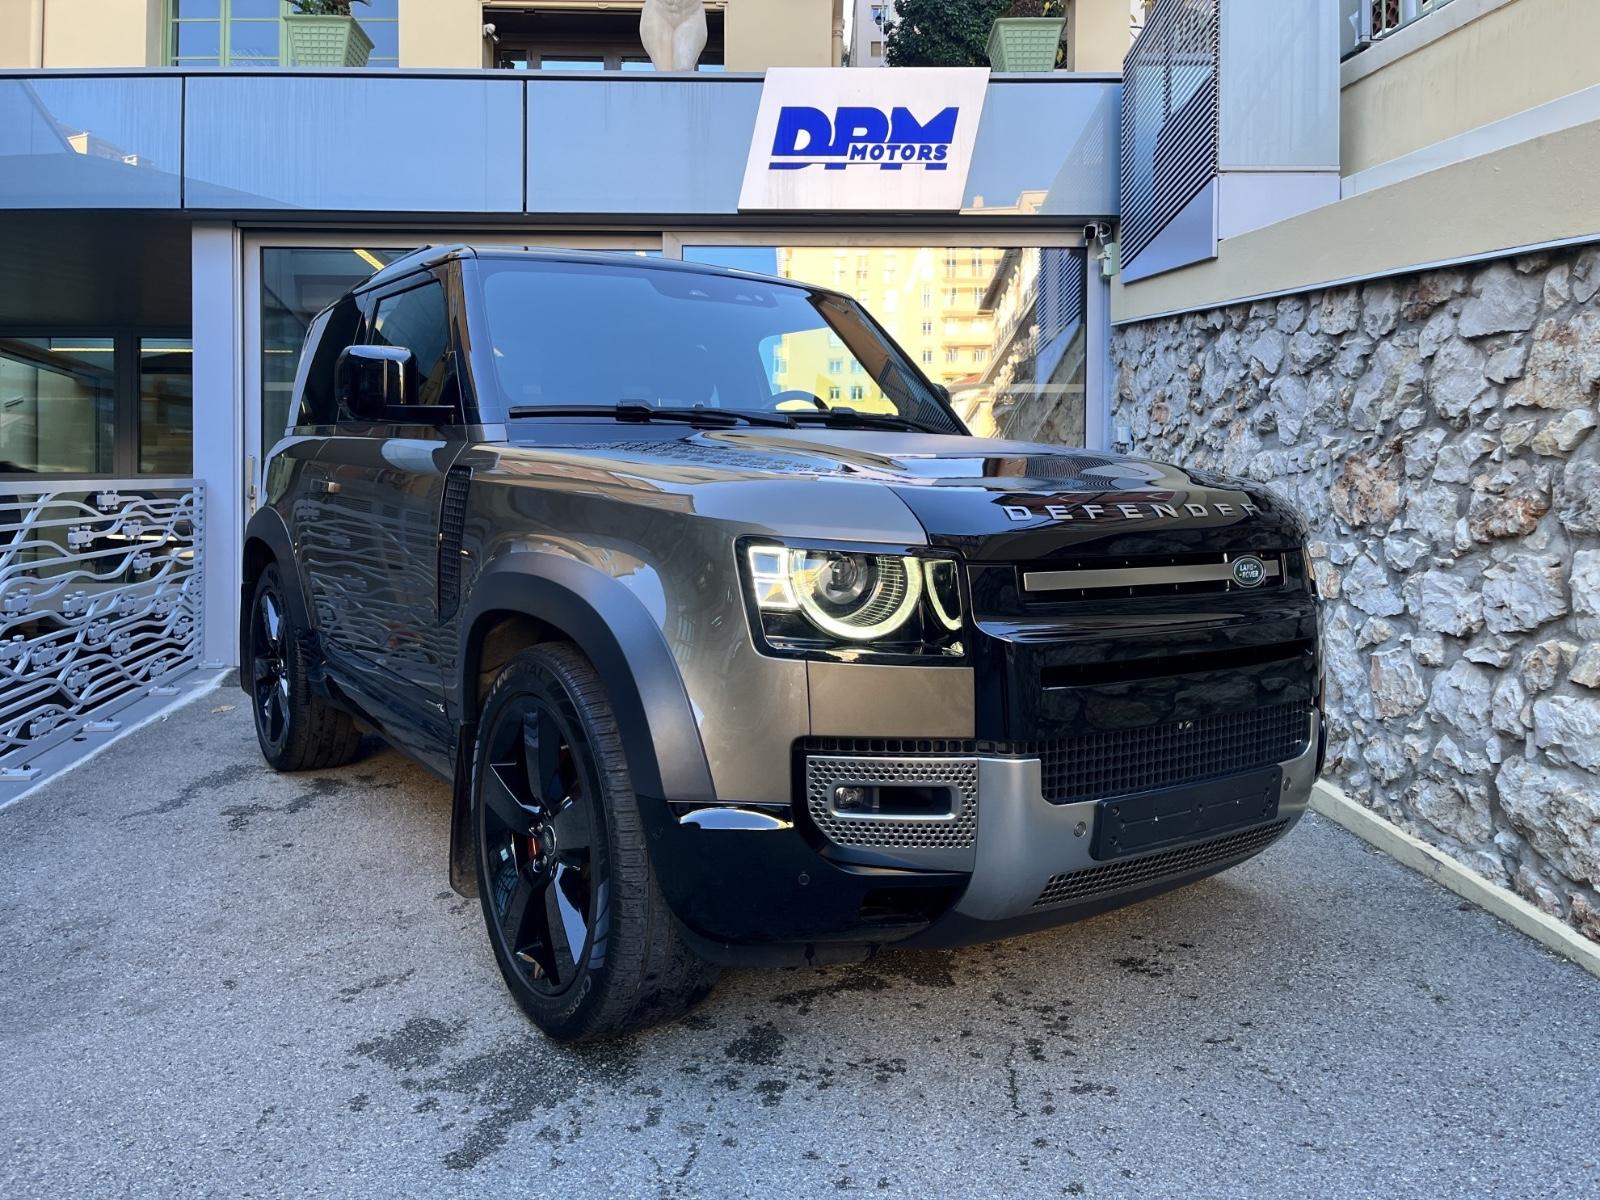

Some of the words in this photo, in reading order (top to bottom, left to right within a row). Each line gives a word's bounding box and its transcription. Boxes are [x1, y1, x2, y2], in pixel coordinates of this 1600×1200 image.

[768, 106, 960, 170] DPM
[849, 144, 948, 161] MOTORS
[1003, 503, 1264, 521] DEFENDER
